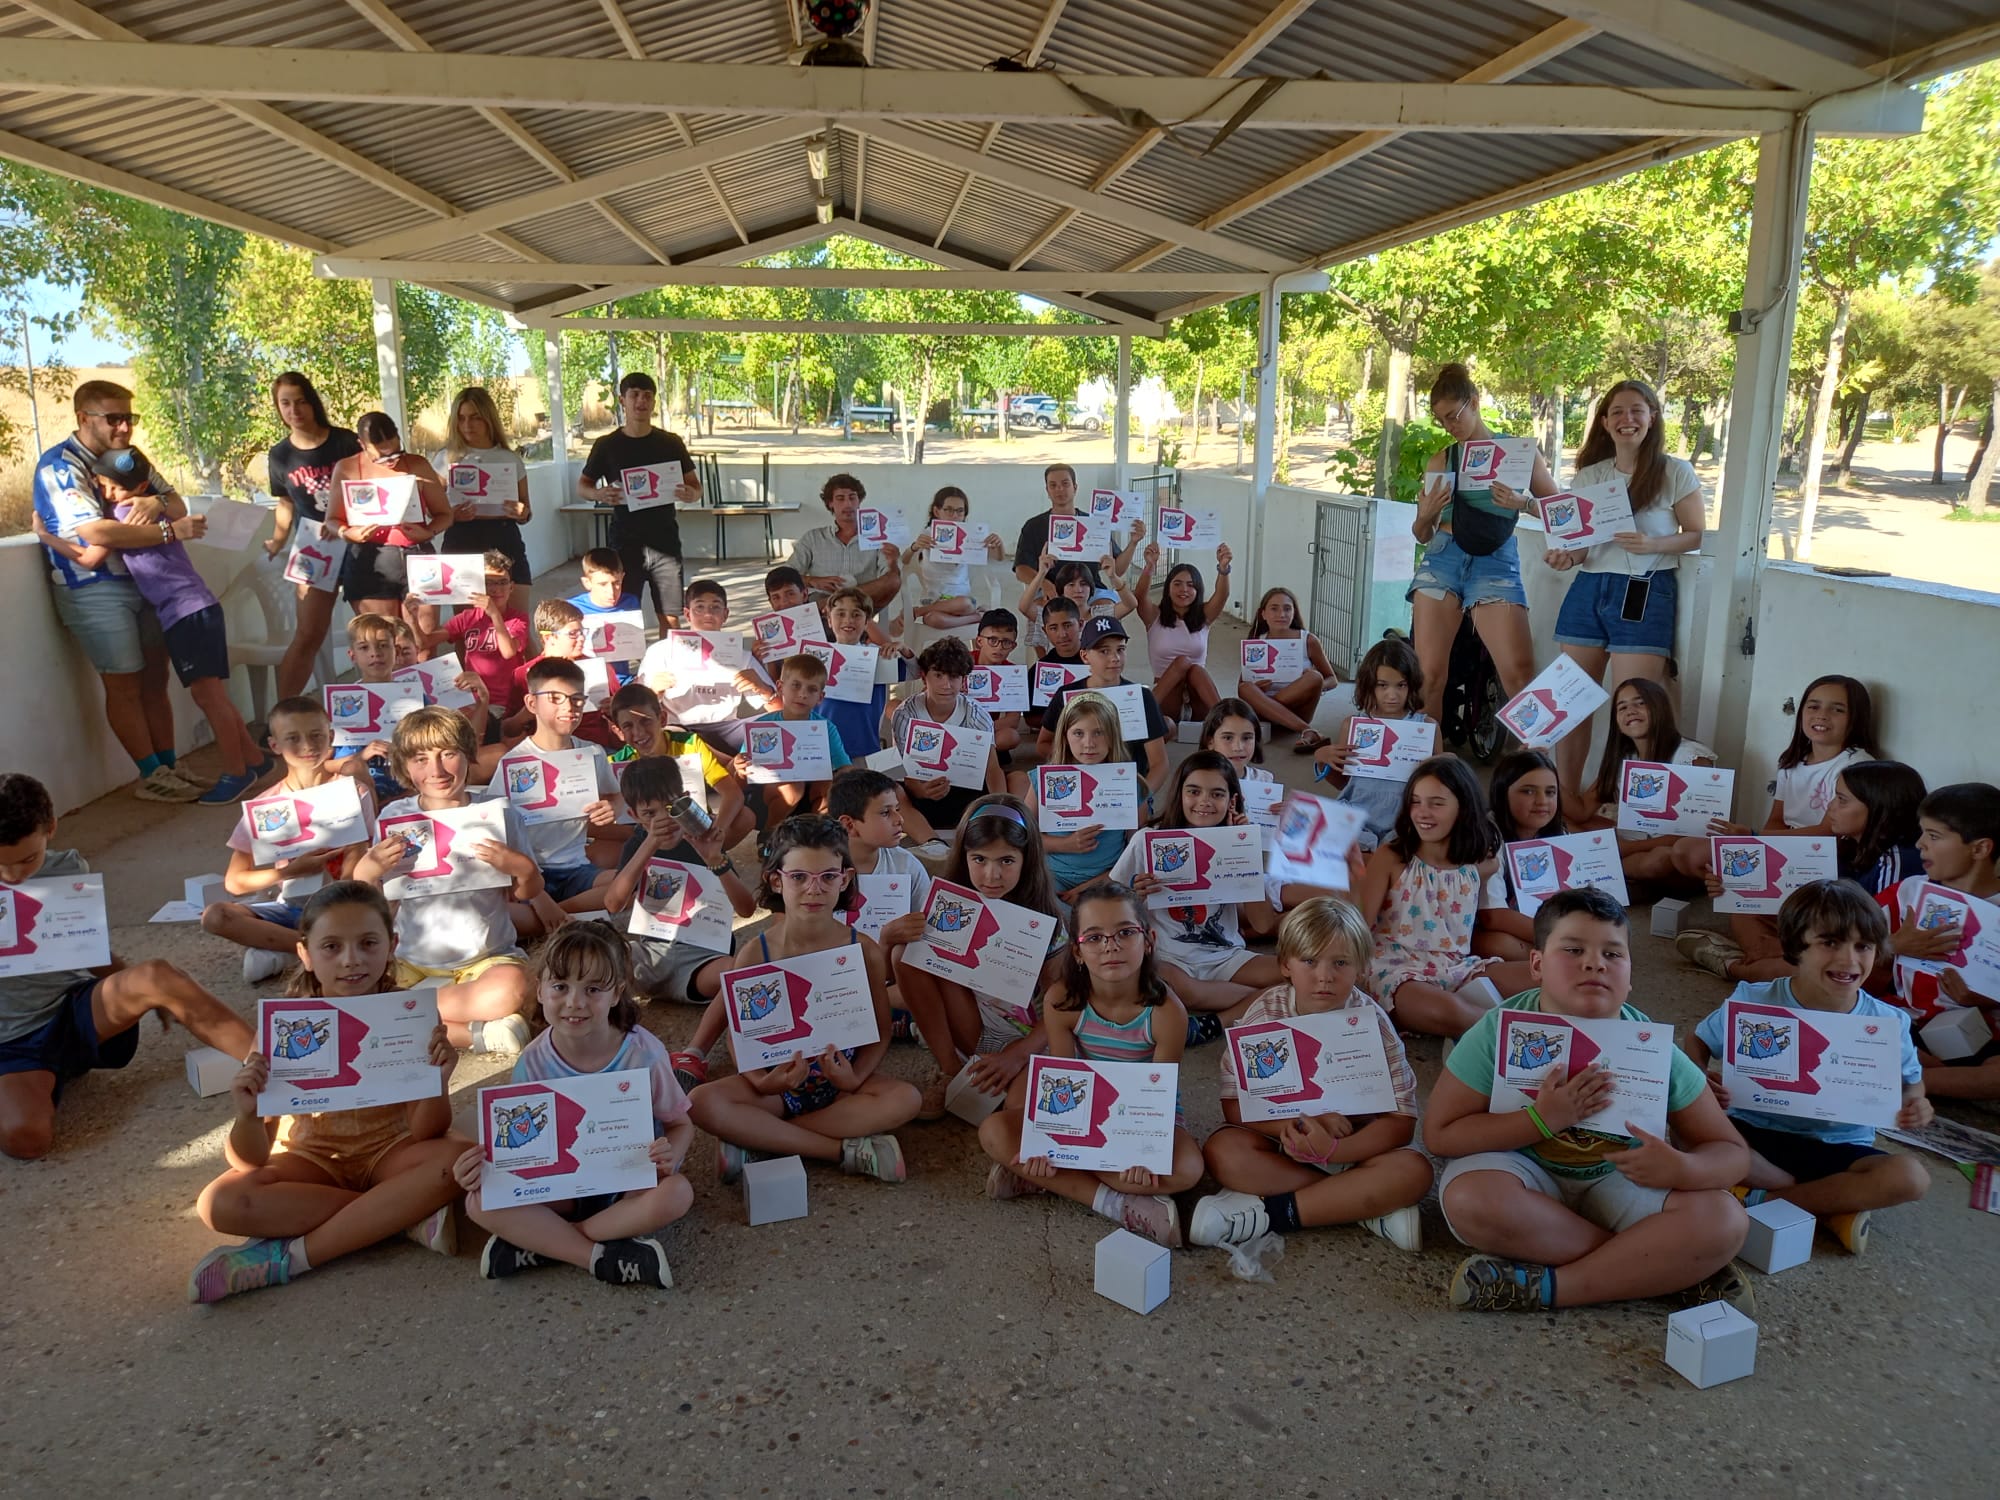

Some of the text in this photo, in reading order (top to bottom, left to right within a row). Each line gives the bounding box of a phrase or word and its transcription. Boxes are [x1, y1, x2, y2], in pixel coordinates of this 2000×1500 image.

[465, 627, 497, 652] GA
[301, 1096, 330, 1106] cesce
[1762, 1097, 1790, 1106] cesce
[1055, 1152, 1080, 1161] cesce
[523, 1186, 551, 1196] cesce
